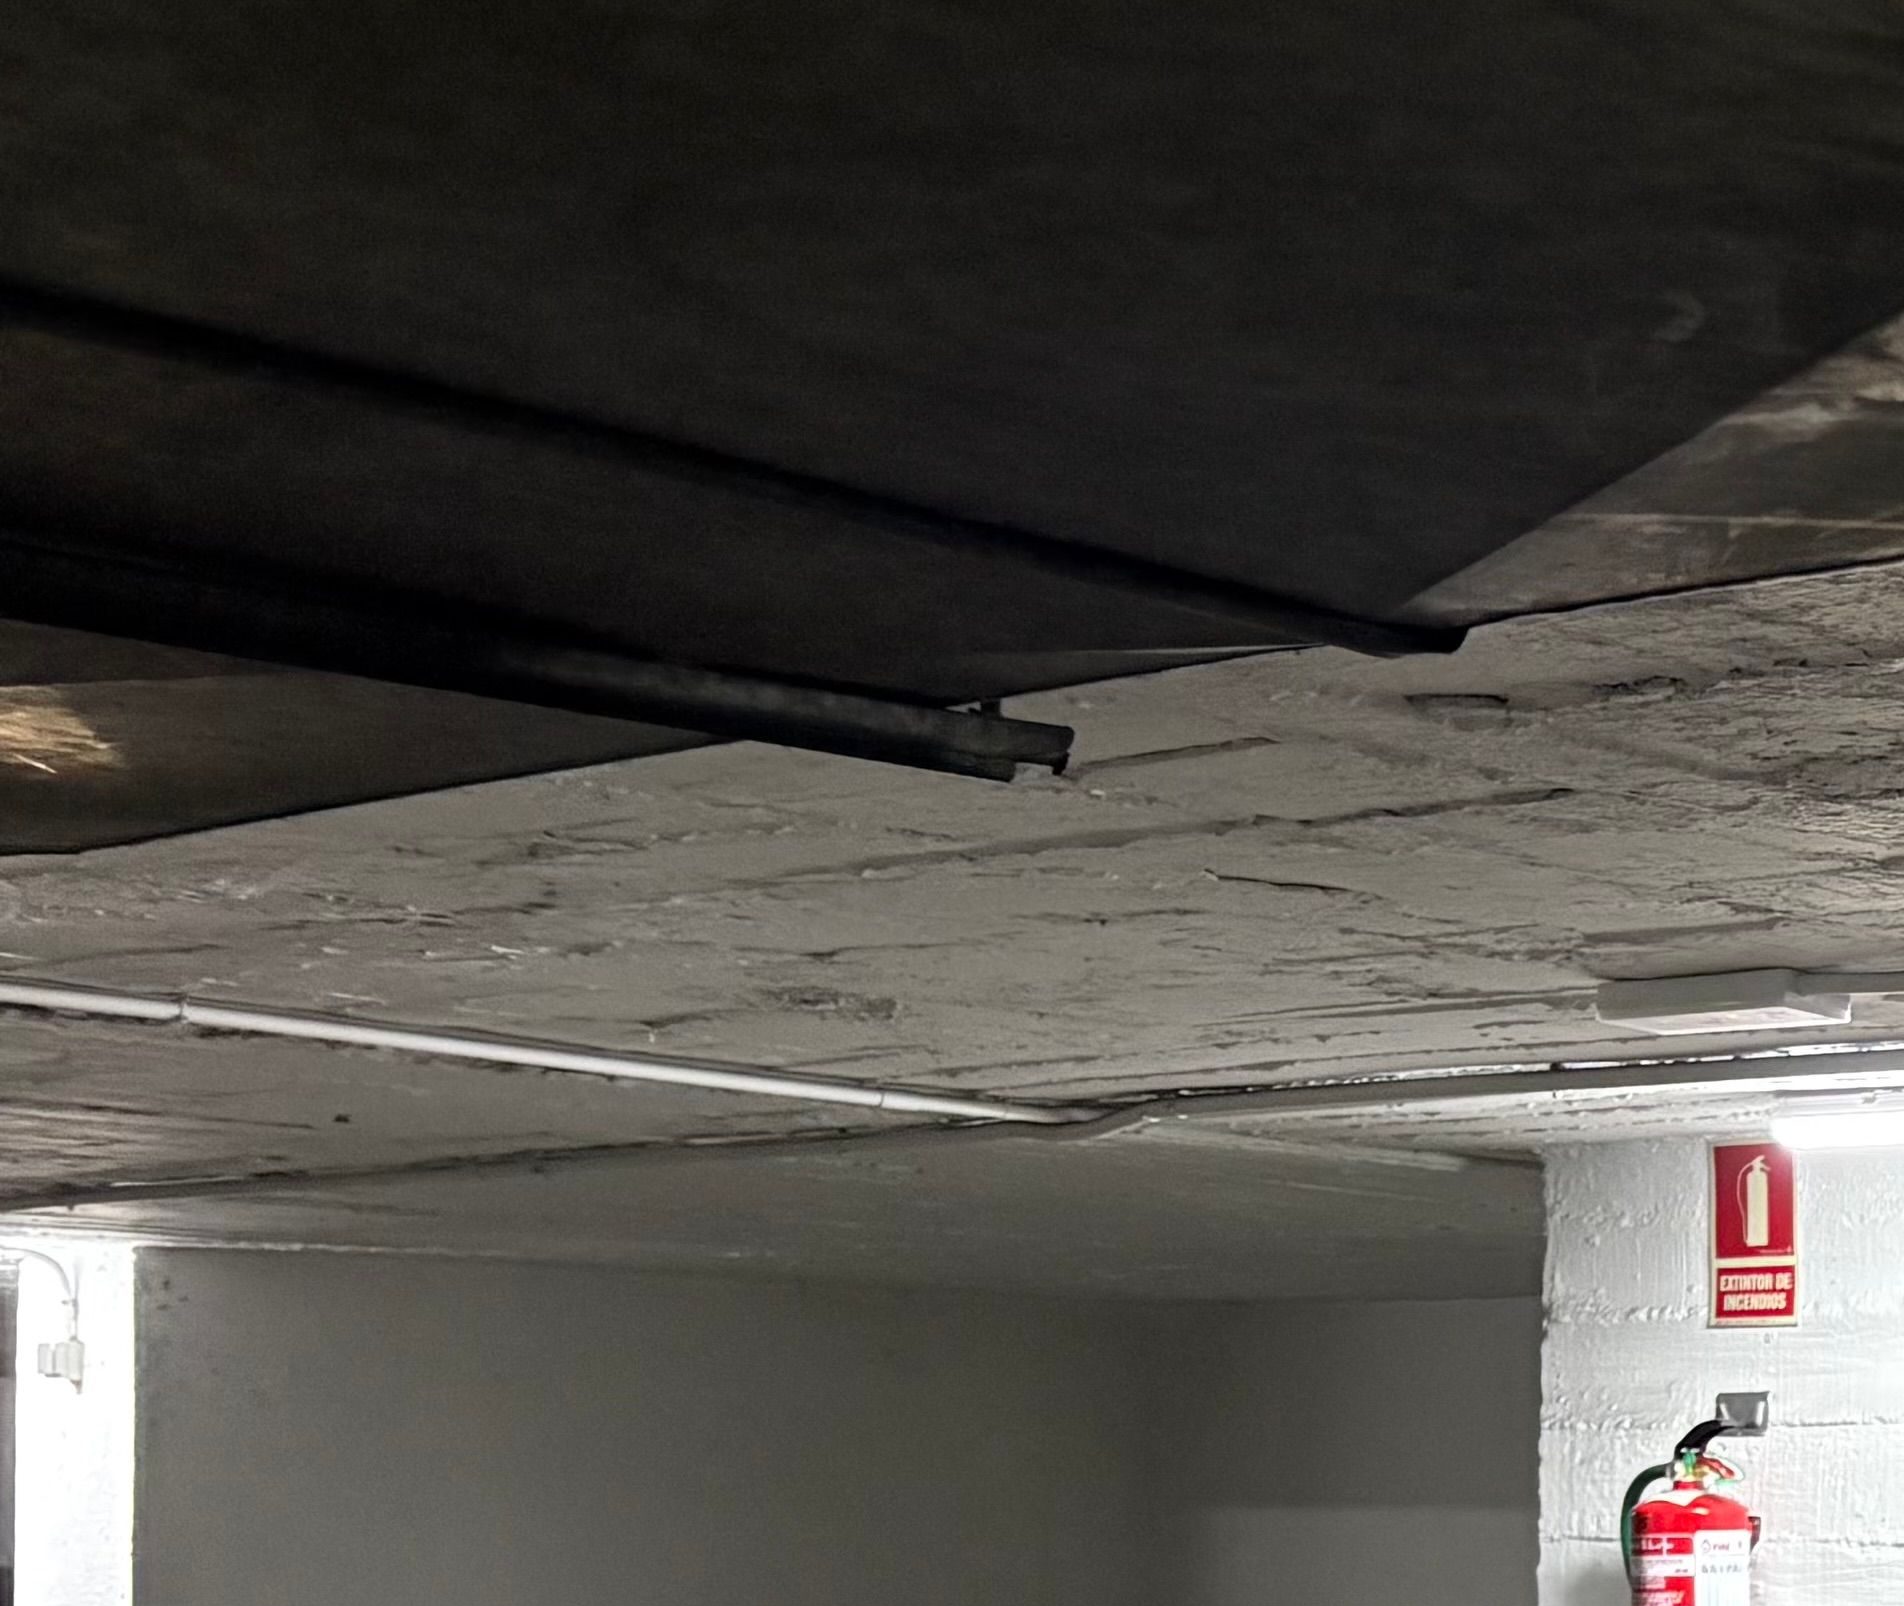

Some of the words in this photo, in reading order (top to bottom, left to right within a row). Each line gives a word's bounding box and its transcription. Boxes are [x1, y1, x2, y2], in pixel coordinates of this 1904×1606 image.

[1720, 1273, 1773, 1291] EXTINTOR
[1775, 1272, 1792, 1290] DE
[1723, 1292, 1786, 1311] INCENDIOS
